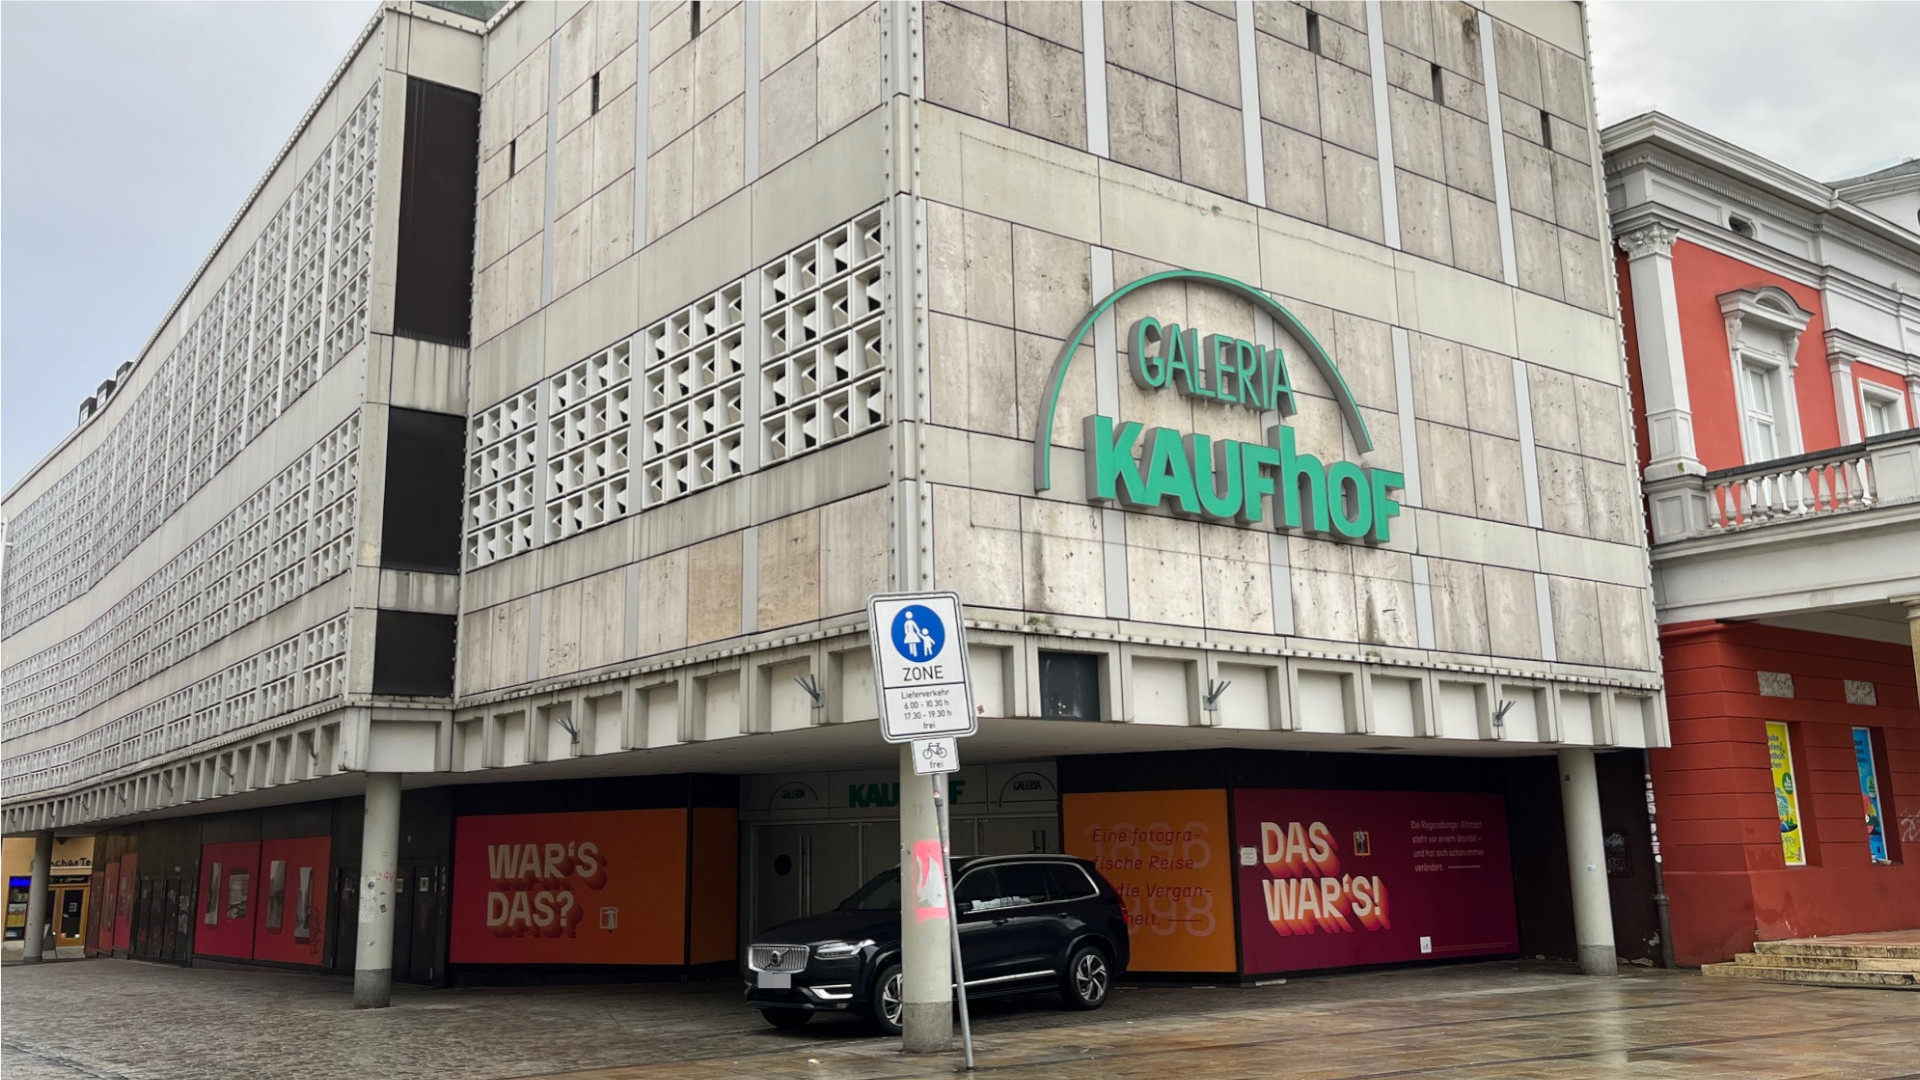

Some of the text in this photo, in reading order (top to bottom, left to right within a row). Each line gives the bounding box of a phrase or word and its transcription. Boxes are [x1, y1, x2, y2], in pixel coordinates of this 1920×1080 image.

[1130, 316, 1297, 417] GALERIA
[902, 665, 944, 682] ZONE
[901, 688, 950, 700] Lieferverkehr
[923, 721, 936, 730] frei
[929, 760, 944, 769] frei
[849, 780, 966, 808] KAUF
[1013, 780, 1042, 792] GALERIA
[1092, 828, 1201, 845] Eine fotogra-
[1261, 822, 1331, 864] DAS
[1148, 855, 1194, 870] Reise
[1117, 883, 1212, 902] die Vergan-
[487, 890, 574, 927] DAS?
